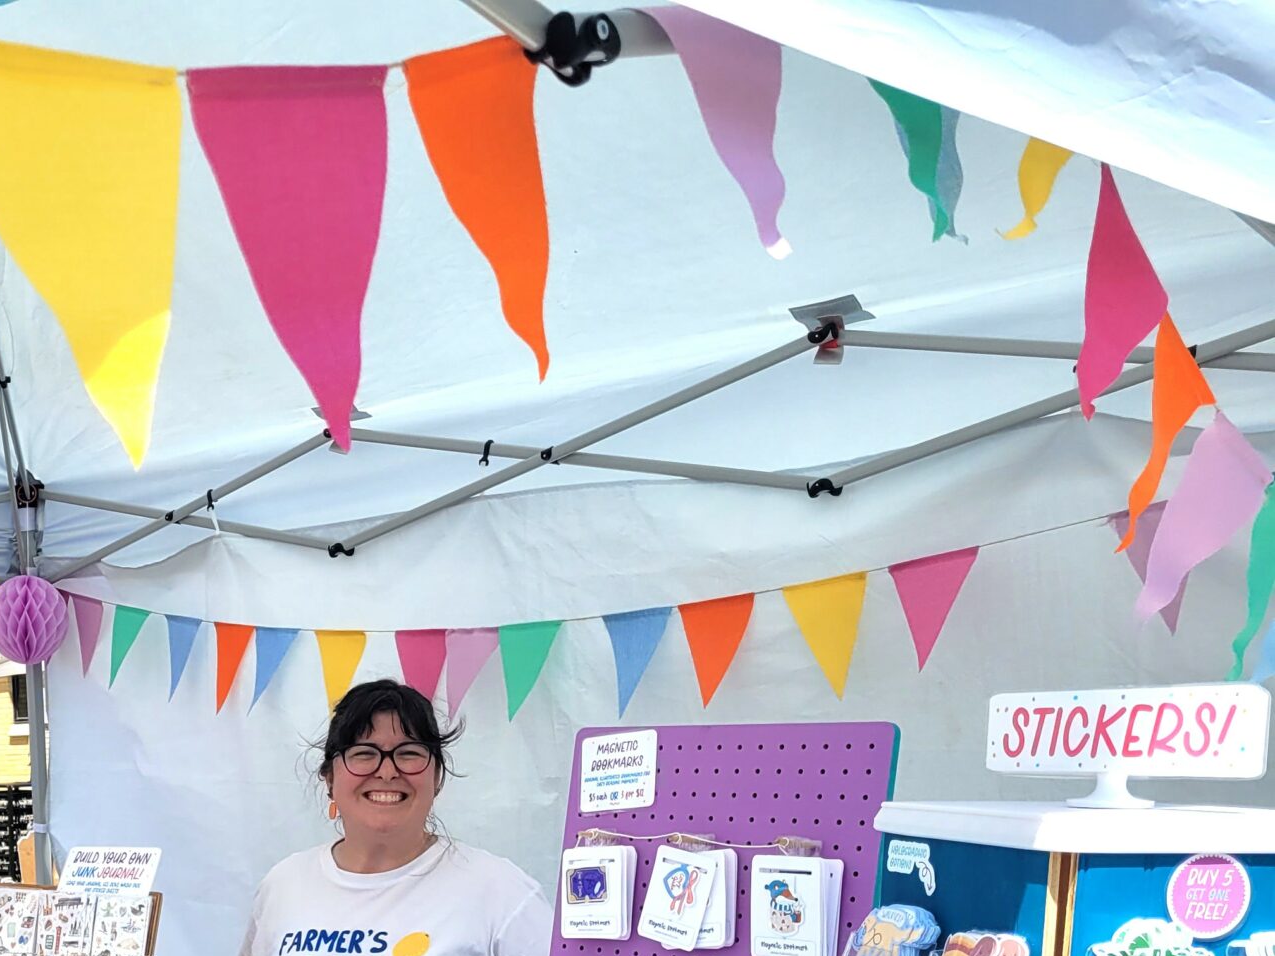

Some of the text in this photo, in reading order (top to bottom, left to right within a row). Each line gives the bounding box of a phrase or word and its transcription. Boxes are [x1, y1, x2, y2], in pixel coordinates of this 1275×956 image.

[1002, 703, 1237, 758] STICKERS!
[597, 740, 638, 756] MAGNETIC
[591, 755, 644, 772] BOOKMARKS
[73, 851, 152, 864] BUILD YOUR OWN
[891, 845, 927, 859] HOLOGRAPHIC
[890, 858, 912, 870] OPTIONS
[72, 866, 145, 880] JUNK JOURNAL!
[1187, 868, 1236, 887] BUY 5
[1186, 887, 1231, 901] GET ONE
[1185, 901, 1229, 921] FREE!
[279, 929, 388, 956] FARMER'S
